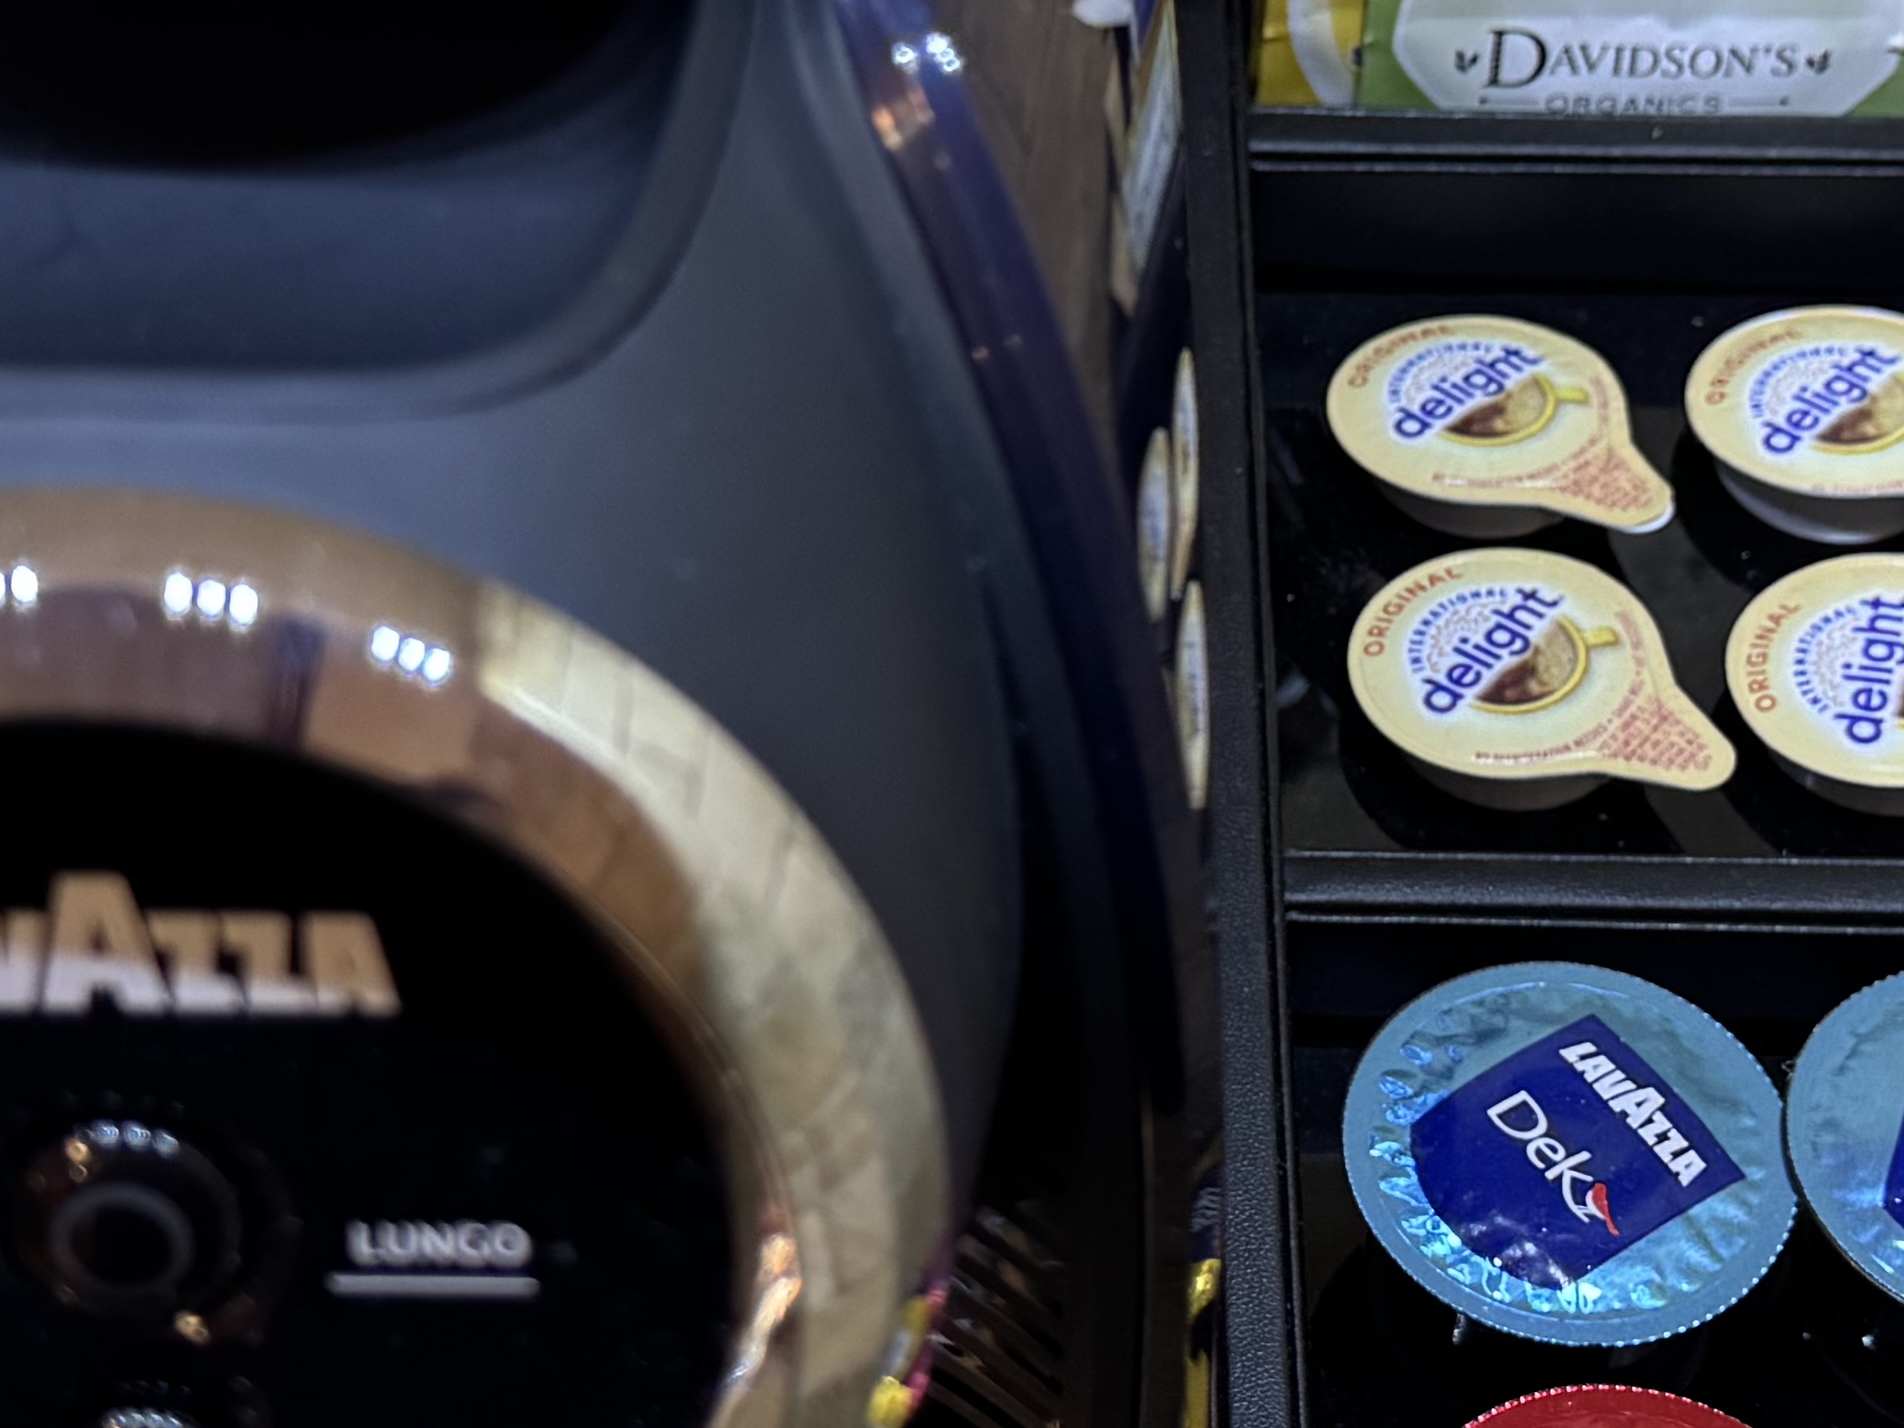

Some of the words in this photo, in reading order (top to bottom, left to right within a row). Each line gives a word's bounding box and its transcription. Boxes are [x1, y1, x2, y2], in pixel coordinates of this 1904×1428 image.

[1484, 27, 1797, 89] DAVIDSON'S
[1545, 92, 1723, 116] ORGANICS
[1393, 346, 1544, 438] delight
[1762, 347, 1901, 453] delight
[1364, 567, 1464, 657] ORIGINAL
[1408, 587, 1508, 674] INTERNATIONAL
[1422, 587, 1565, 713] delight
[1746, 603, 1802, 713] ORIGINAL
[1793, 605, 1856, 713] INTERNATIONAL
[345, 1221, 533, 1267] LUNGO
